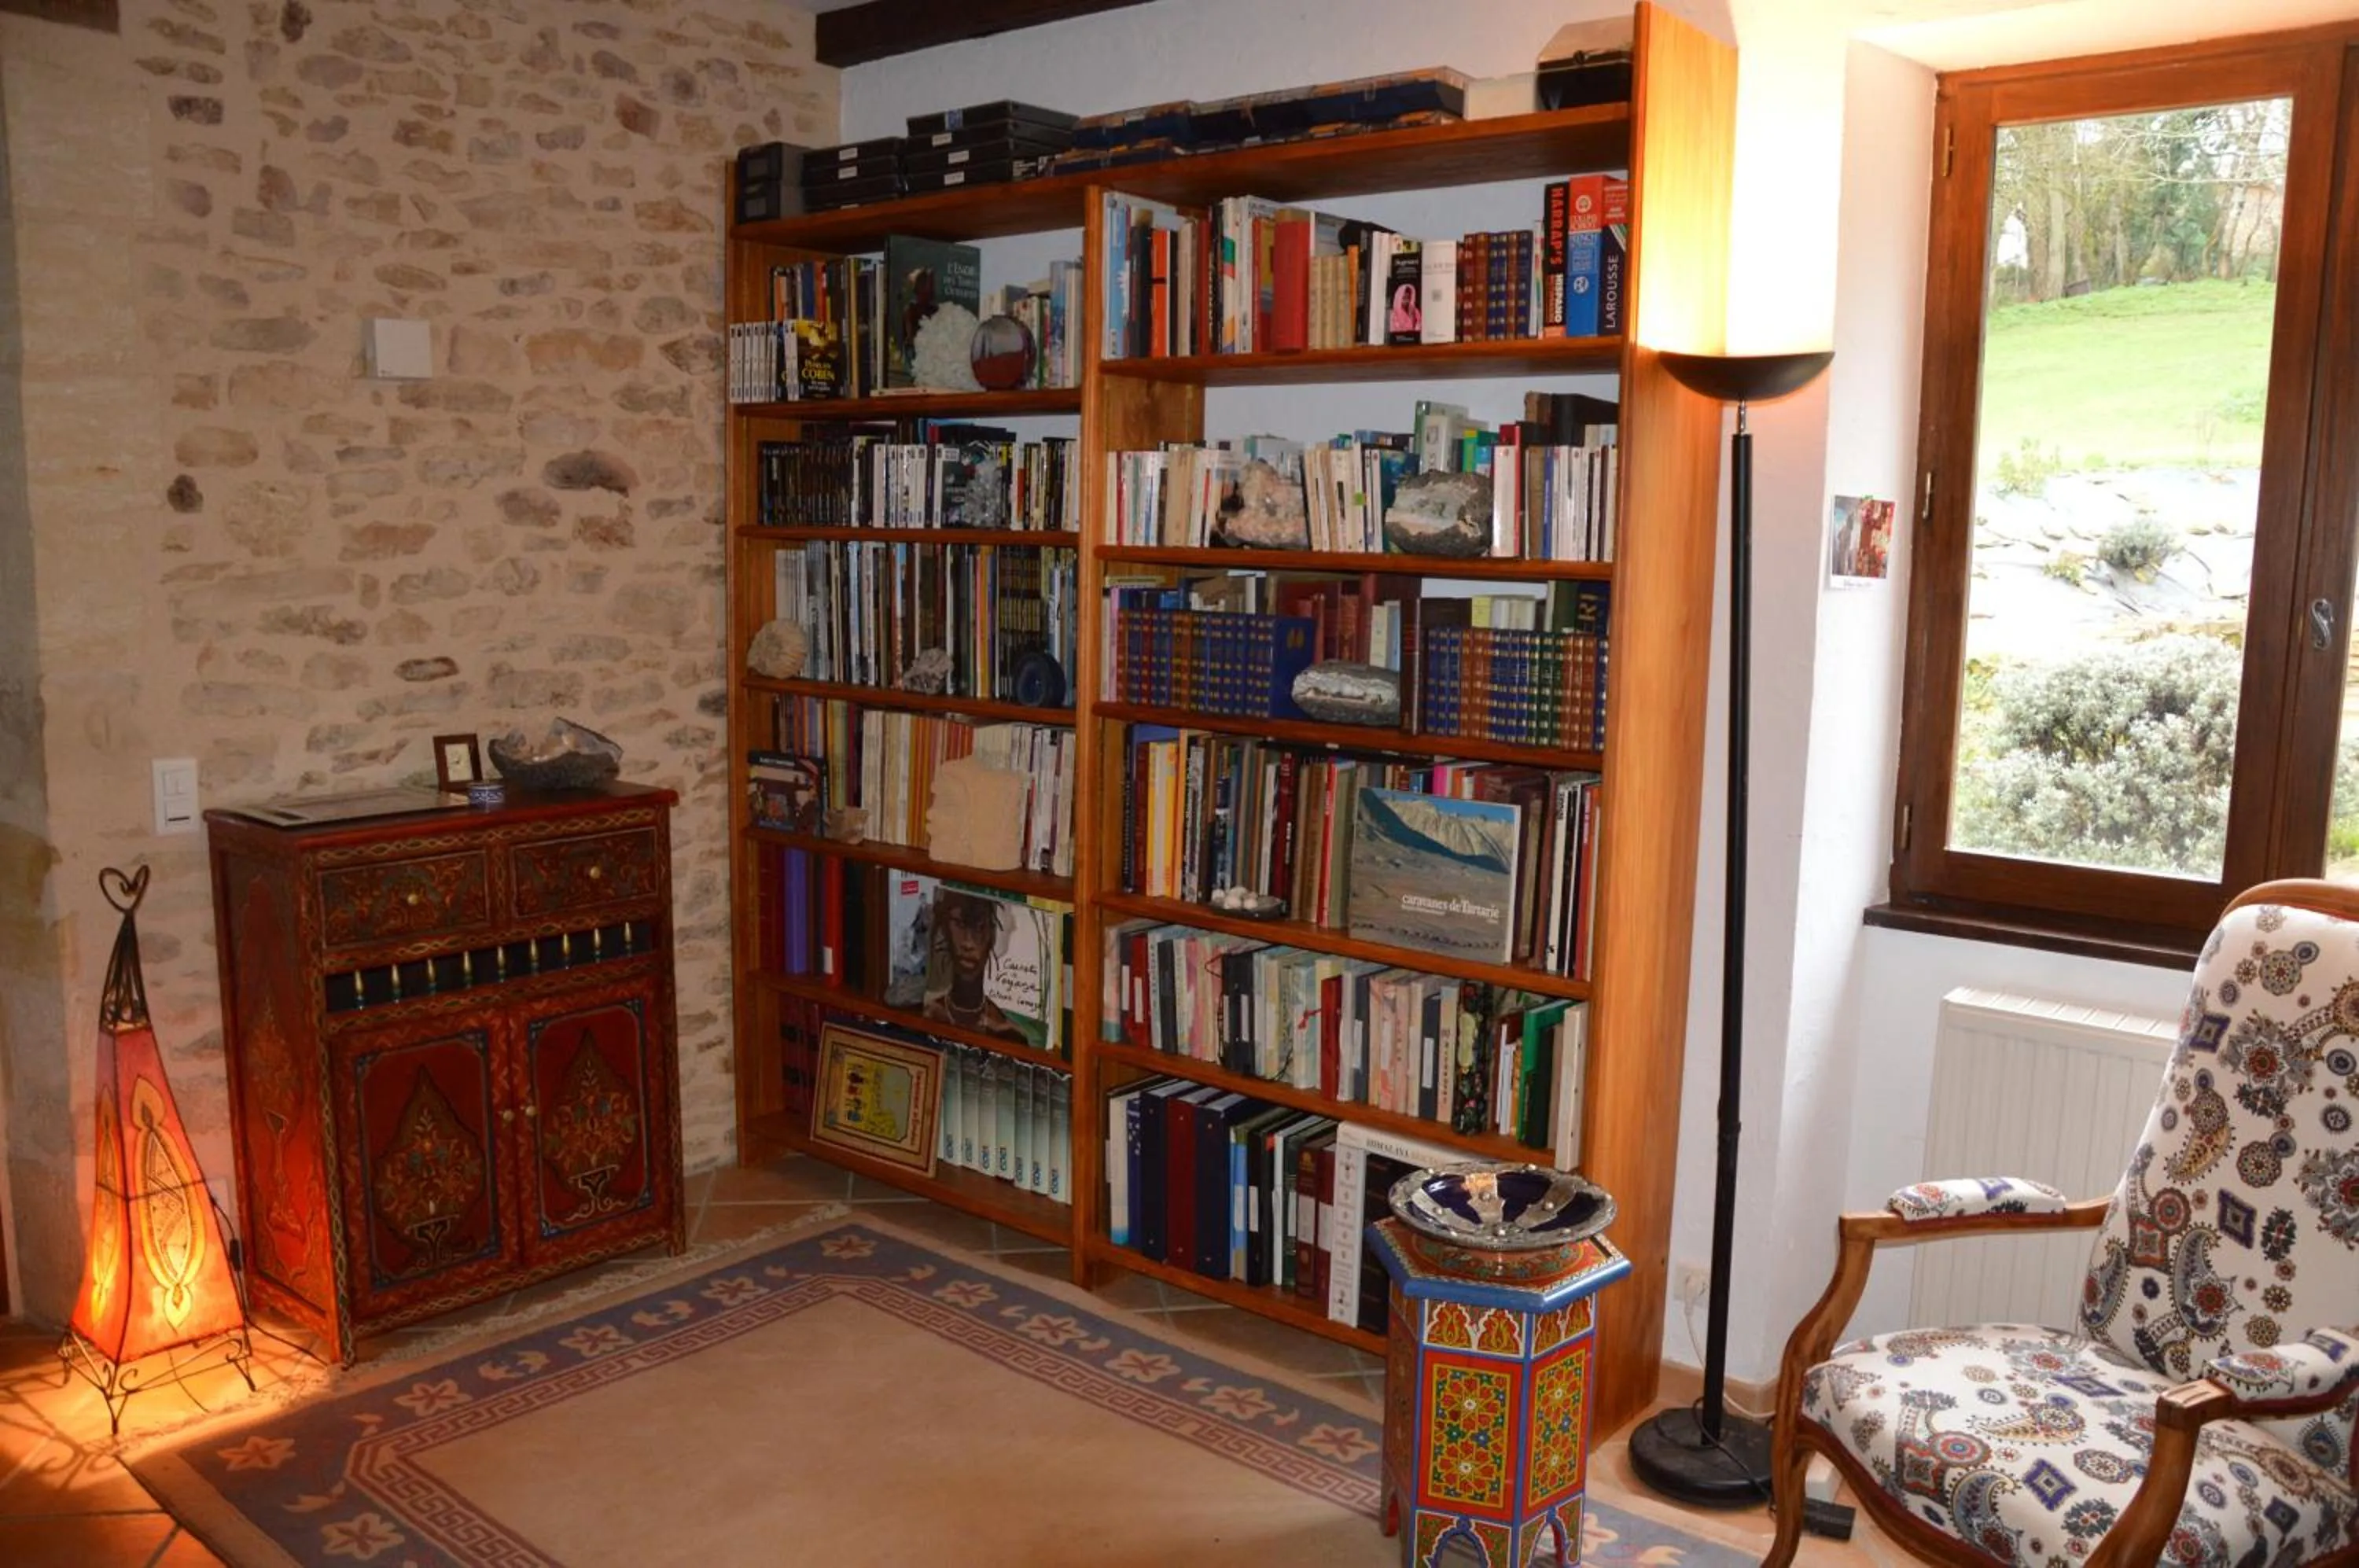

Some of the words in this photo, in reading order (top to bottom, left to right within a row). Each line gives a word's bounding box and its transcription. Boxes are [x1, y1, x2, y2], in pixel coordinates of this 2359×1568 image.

[1551, 187, 1564, 266] HARRAP'S
[1605, 256, 1619, 329] LAROUSSE
[1402, 894, 1447, 910] caravanes
[1449, 898, 1461, 912] de
